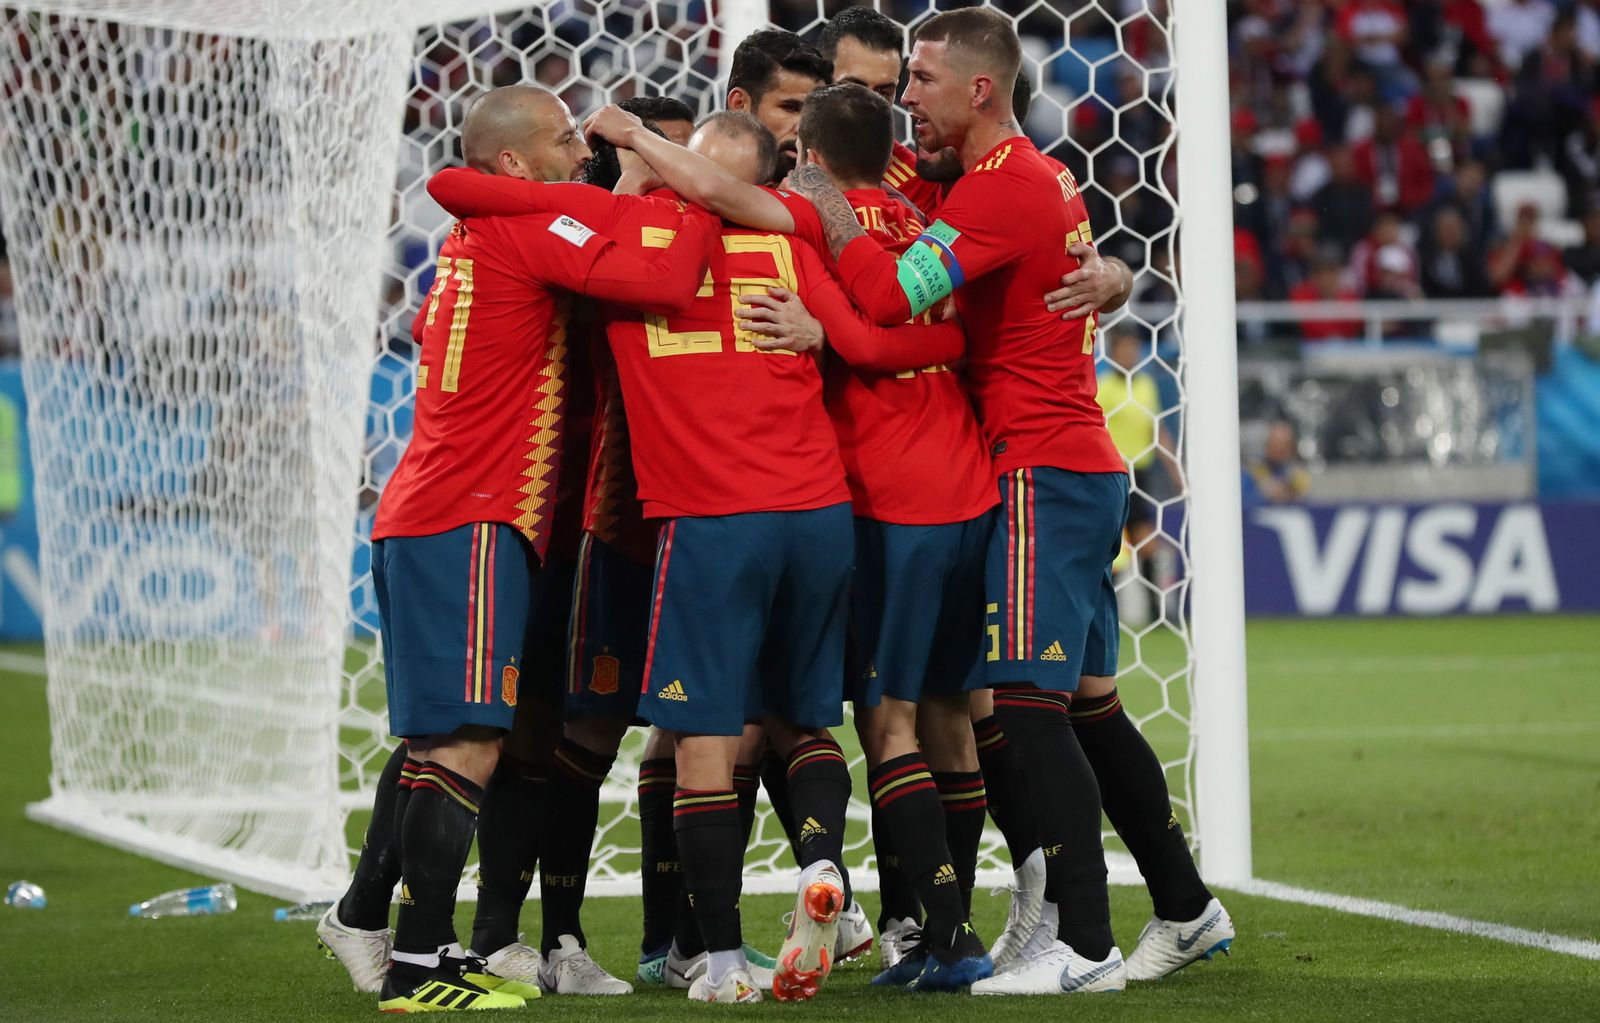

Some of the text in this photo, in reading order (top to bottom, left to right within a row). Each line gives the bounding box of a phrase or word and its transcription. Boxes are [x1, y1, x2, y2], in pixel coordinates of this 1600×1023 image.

[913, 284, 926, 306] FIFA
[1254, 504, 1560, 614] VISA
[1040, 652, 1067, 662] adidas
[658, 691, 688, 702] adidas
